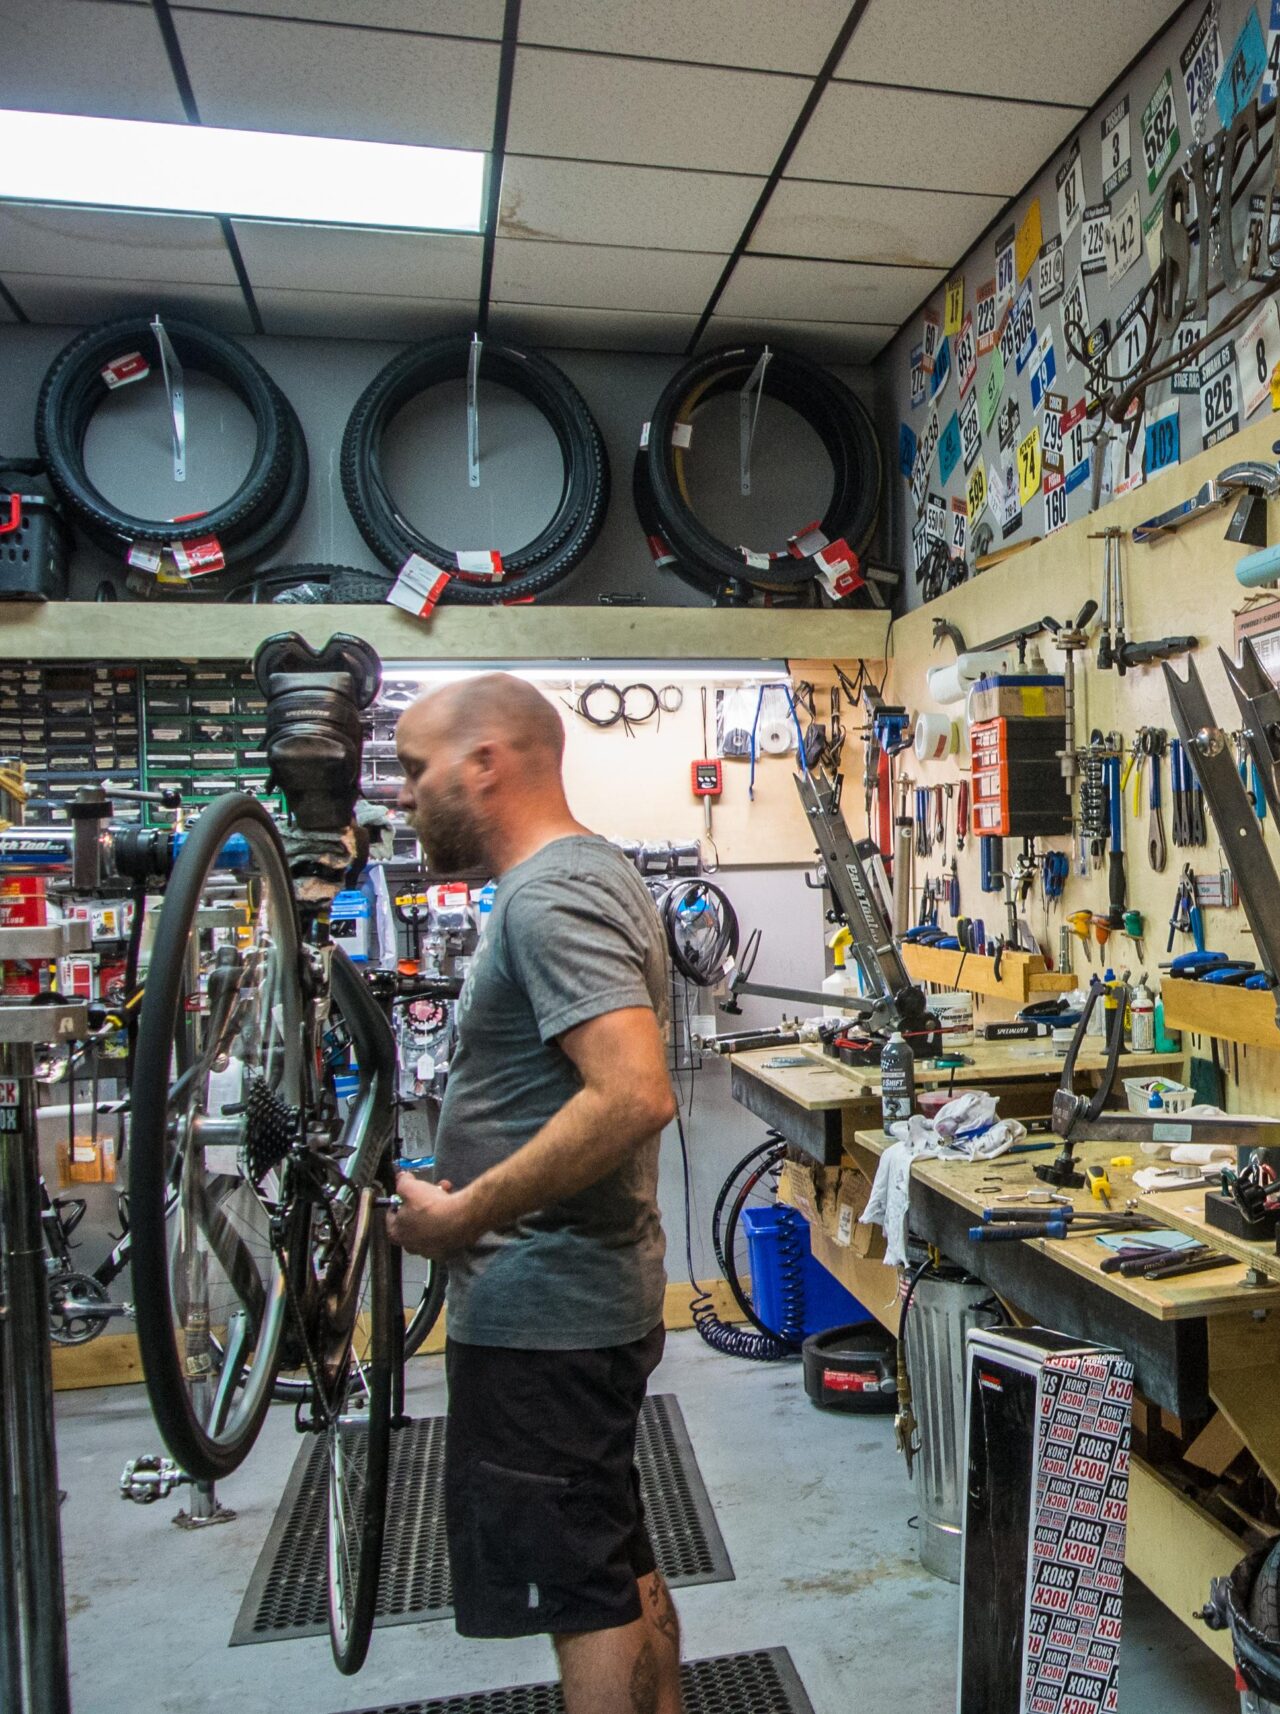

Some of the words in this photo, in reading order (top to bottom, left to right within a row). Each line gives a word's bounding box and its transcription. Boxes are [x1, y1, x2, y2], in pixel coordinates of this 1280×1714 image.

[1143, 94, 1175, 170] 582
[1112, 132, 1120, 168] 3
[1065, 169, 1076, 216] 87
[1111, 215, 1134, 265] 142
[978, 297, 995, 335] 223
[1014, 299, 1034, 354] 509
[1124, 324, 1140, 369] 71
[1202, 353, 1221, 381] SWANK
[1256, 338, 1268, 384] 8
[1189, 372, 1201, 388] RAC
[1204, 373, 1232, 428] 826
[1019, 430, 1037, 457] ICYCLE
[1070, 424, 1083, 466] 19
[1152, 420, 1174, 469] 103
[1022, 446, 1036, 488] 74
[1046, 485, 1066, 531] 160
[954, 514, 965, 545] 26
[845, 863, 864, 898] Park
[858, 897, 879, 930] Tool
[1083, 1363, 1106, 1380] ROCK
[1065, 1377, 1088, 1394] SHOX
[1060, 1391, 1084, 1408] ROCK
[1056, 1410, 1079, 1427] SHOX
[1101, 1404, 1124, 1421] SHOX
[1051, 1424, 1075, 1441] ROCK
[1096, 1418, 1120, 1435] ROCK
[1046, 1444, 1069, 1461] SHOX
[1077, 1436, 1112, 1461] SHOX
[1042, 1458, 1065, 1475] ROCK
[1071, 1457, 1107, 1482] ROCK
[1049, 1478, 1073, 1496] SHOX
[1077, 1485, 1101, 1502] SHOX
[1045, 1493, 1068, 1511] ROCK
[1073, 1500, 1097, 1517] ROCK
[1035, 1527, 1059, 1544] SHOX
[1067, 1519, 1103, 1545] SHOX
[1033, 1541, 1055, 1558] ROCK
[1061, 1541, 1097, 1566] ROCK
[1040, 1564, 1076, 1589] SHOX
[1100, 1559, 1124, 1576] SHOX
[1095, 1573, 1119, 1590] ROCK
[1034, 1586, 1070, 1610] ROCK
[1076, 1587, 1100, 1604] SHOX
[1073, 1600, 1096, 1618] ROCK
[1054, 1616, 1078, 1633] SHOX
[1050, 1629, 1074, 1647] ROCK
[1044, 1649, 1068, 1667] SHOX
[1090, 1642, 1114, 1659] SHOX
[1041, 1664, 1064, 1680] ROCK
[1086, 1656, 1110, 1673] ROCK
[1035, 1684, 1059, 1700] SHOX
[1067, 1674, 1102, 1700] SHOX
[1031, 1697, 1055, 1714] ROCK
[1062, 1695, 1097, 1714] ROCK
